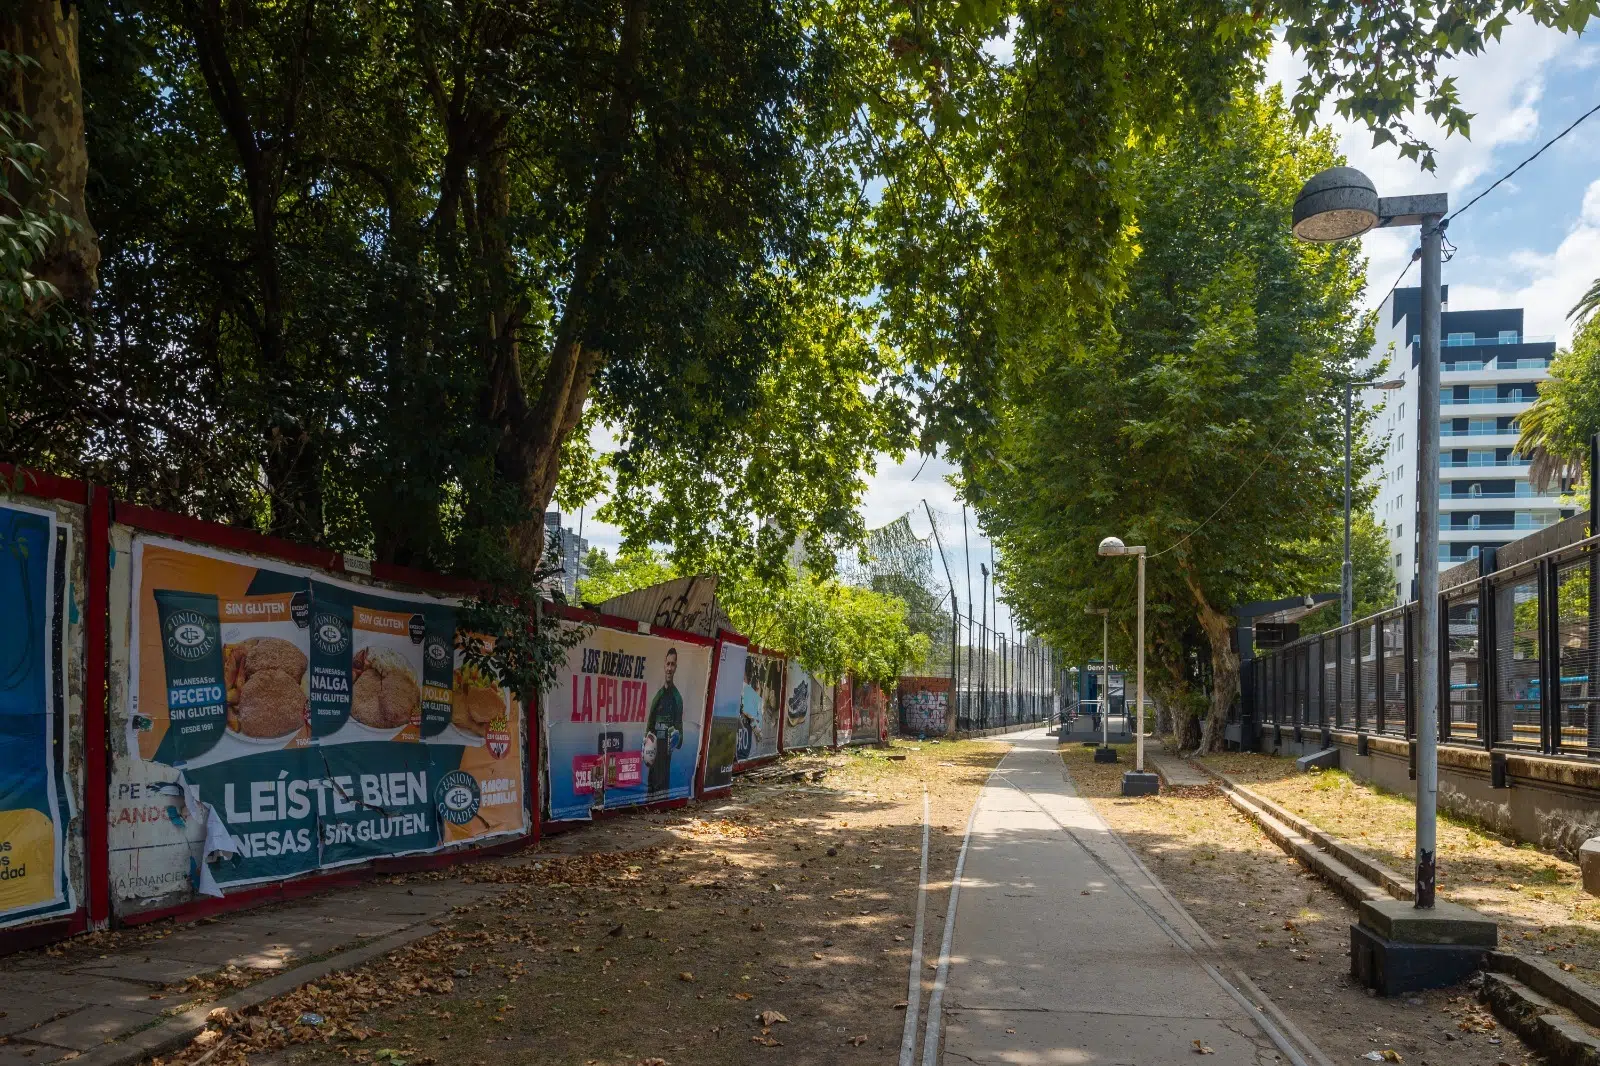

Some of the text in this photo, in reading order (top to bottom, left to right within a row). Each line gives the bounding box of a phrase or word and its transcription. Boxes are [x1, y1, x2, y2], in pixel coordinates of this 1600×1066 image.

[225, 602, 284, 615] SIN GLUTEN
[170, 612, 206, 627] UNION
[319, 613, 343, 628] UNION
[359, 613, 404, 629] SIN GLUTEN
[168, 635, 214, 658] GANADERA
[314, 632, 348, 654] GANADERA
[314, 666, 341, 676] MILANESAS
[581, 648, 647, 679] LOS DUEÑOS DE
[173, 677, 209, 687] MILANESAS
[311, 675, 349, 692] NALGA
[170, 686, 222, 705] PECETO
[311, 692, 350, 703] SIN GLUTEN
[571, 674, 648, 722] LA PELOTA
[170, 705, 224, 721] SIN GLUTEN
[430, 702, 451, 713] GLUTEN
[180, 723, 214, 735] DESDE 1991
[442, 772, 473, 791] UNION
[224, 769, 428, 824] LEÍSTE BIEN
[438, 797, 480, 823] GANADERA
[230, 828, 312, 858] NESAS
[357, 812, 430, 842] GLUTEN.
[0, 863, 26, 881] dad
